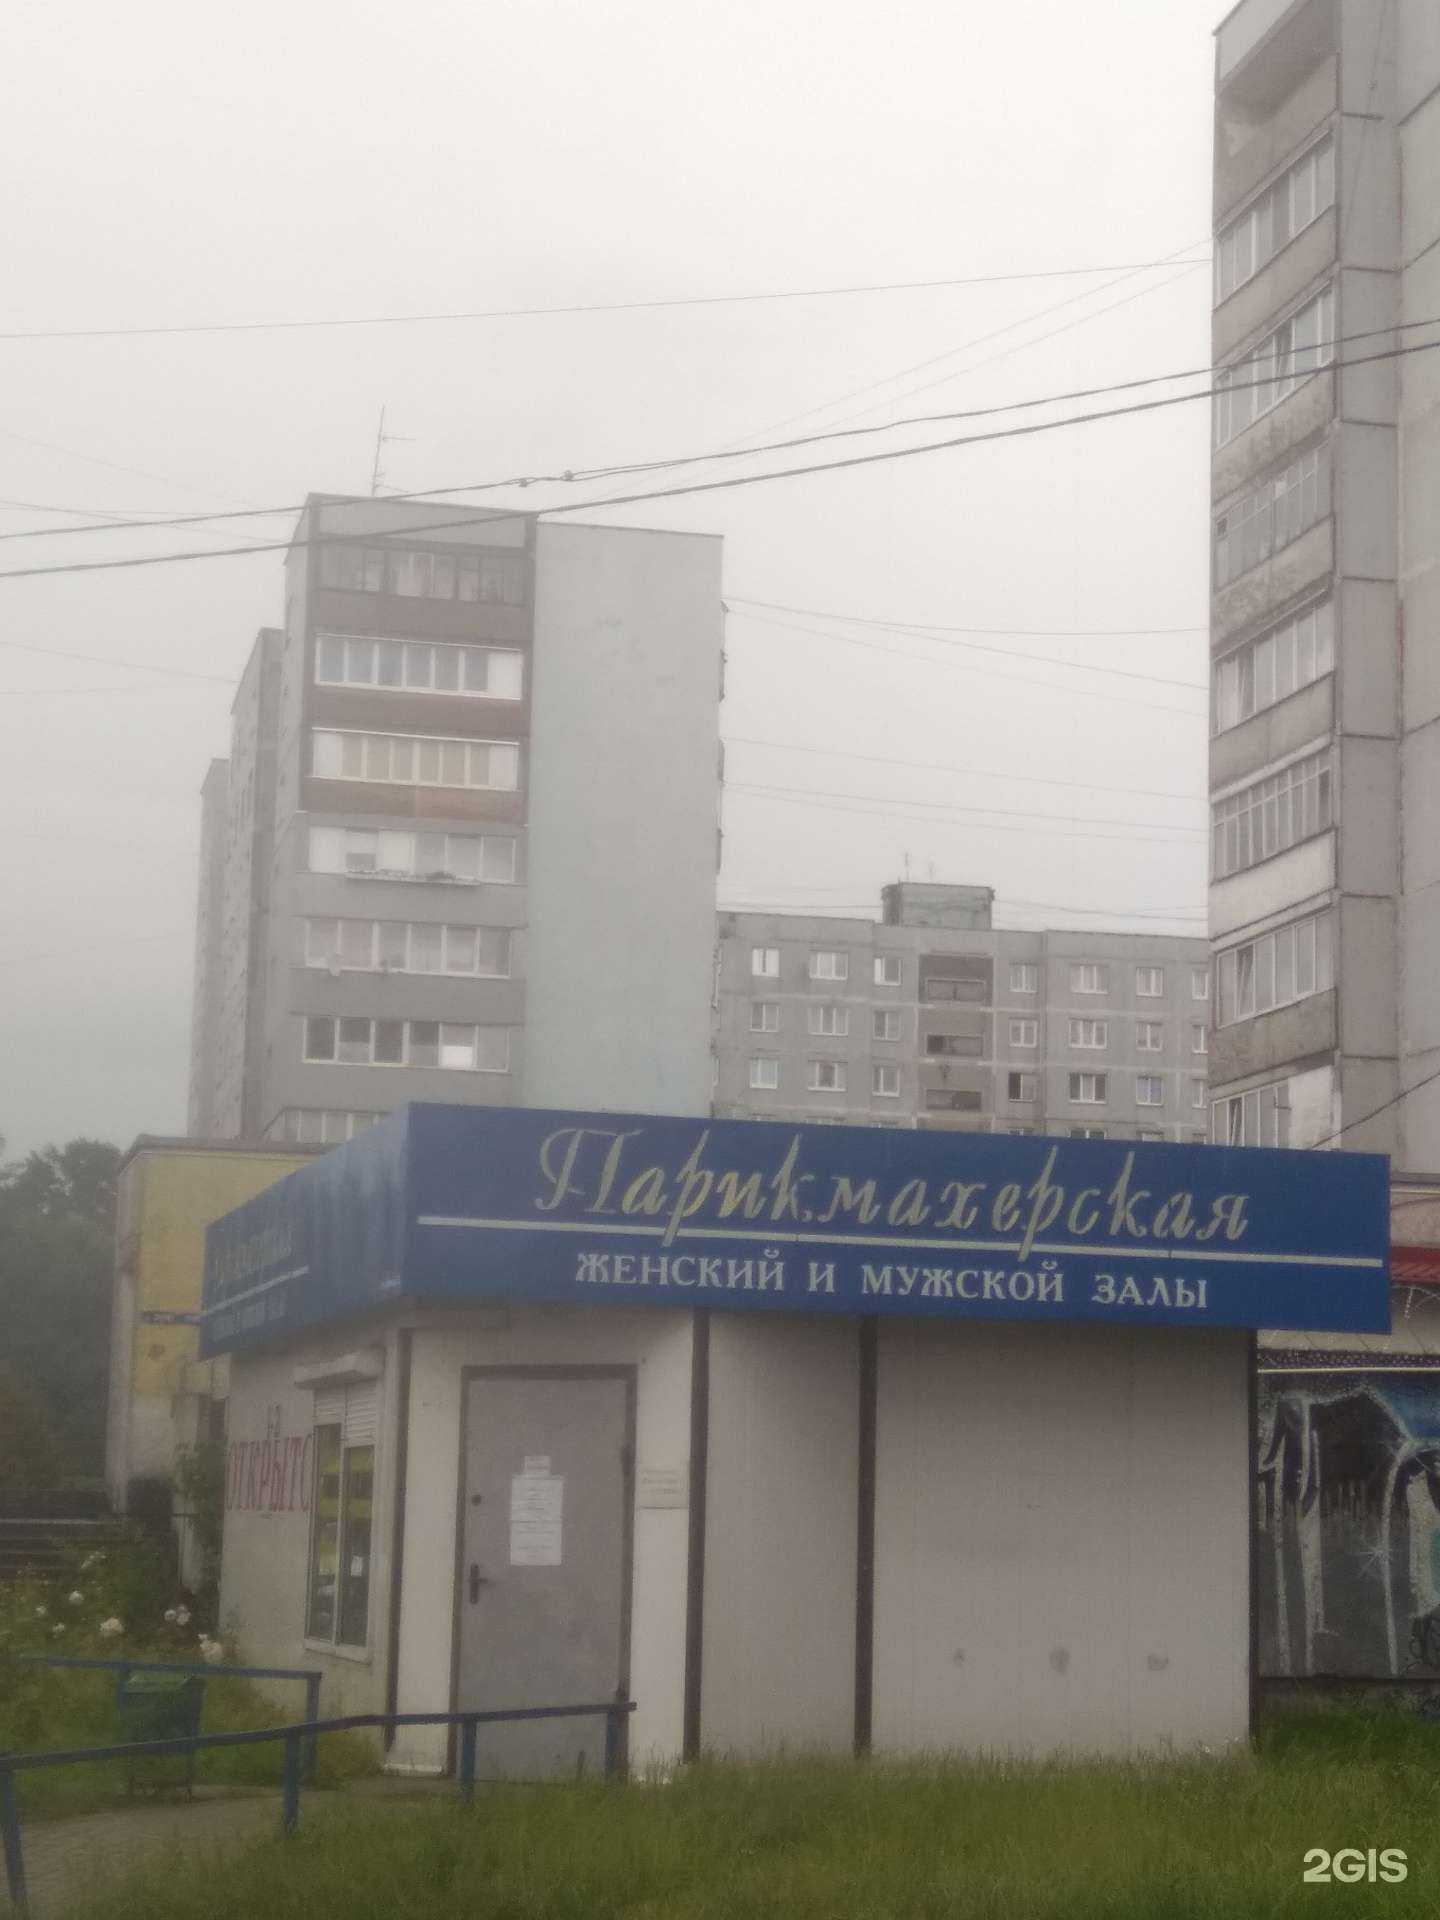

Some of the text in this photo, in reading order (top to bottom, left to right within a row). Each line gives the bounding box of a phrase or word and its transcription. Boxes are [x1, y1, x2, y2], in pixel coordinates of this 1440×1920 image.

[535, 1127, 1249, 1261] Парикмахерская
[575, 1248, 1208, 1308] ЖЕНСКИЙ И МУЖСКОЙ ЗАЛЫ
